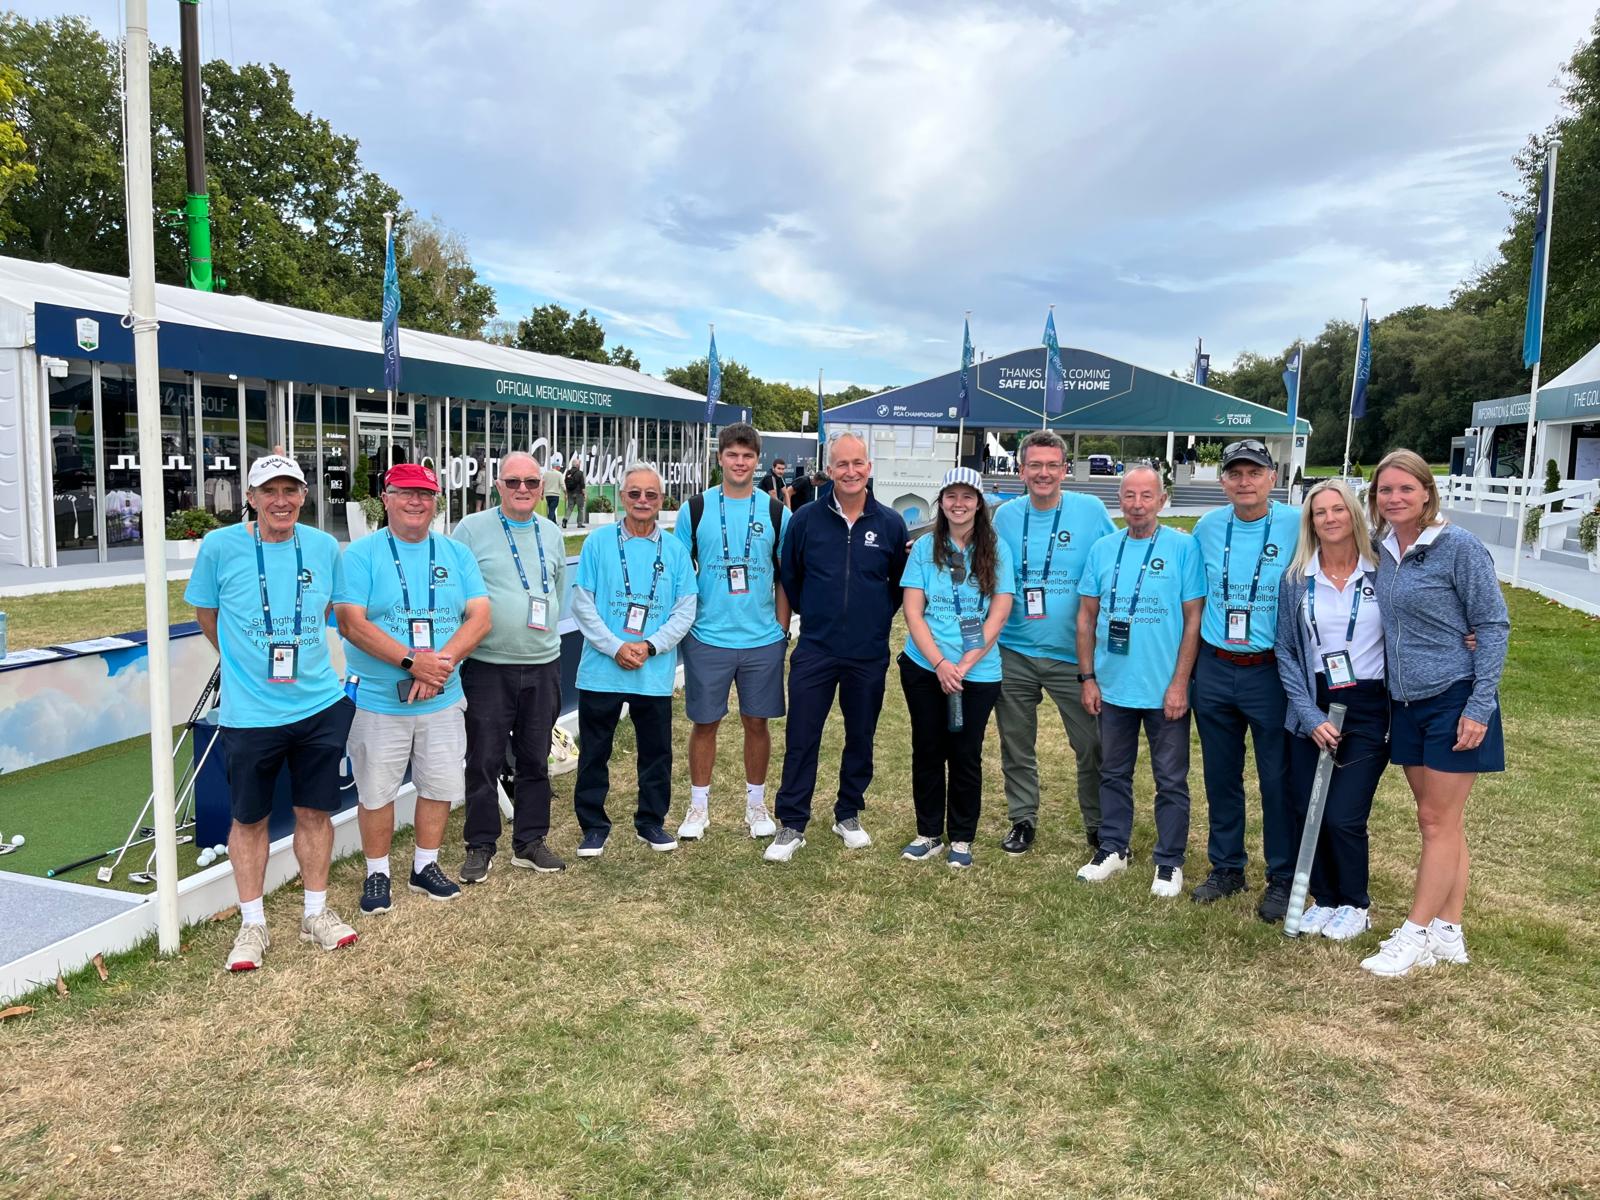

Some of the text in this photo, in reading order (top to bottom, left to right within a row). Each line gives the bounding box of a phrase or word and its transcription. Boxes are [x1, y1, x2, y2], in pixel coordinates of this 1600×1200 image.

[1000, 368, 1042, 378] THANKS
[1069, 369, 1111, 379] COMING
[998, 380, 1110, 390] SAFE JOUEY HOME
[496, 379, 612, 407] OFFICIAL MERCHANDISE STORE
